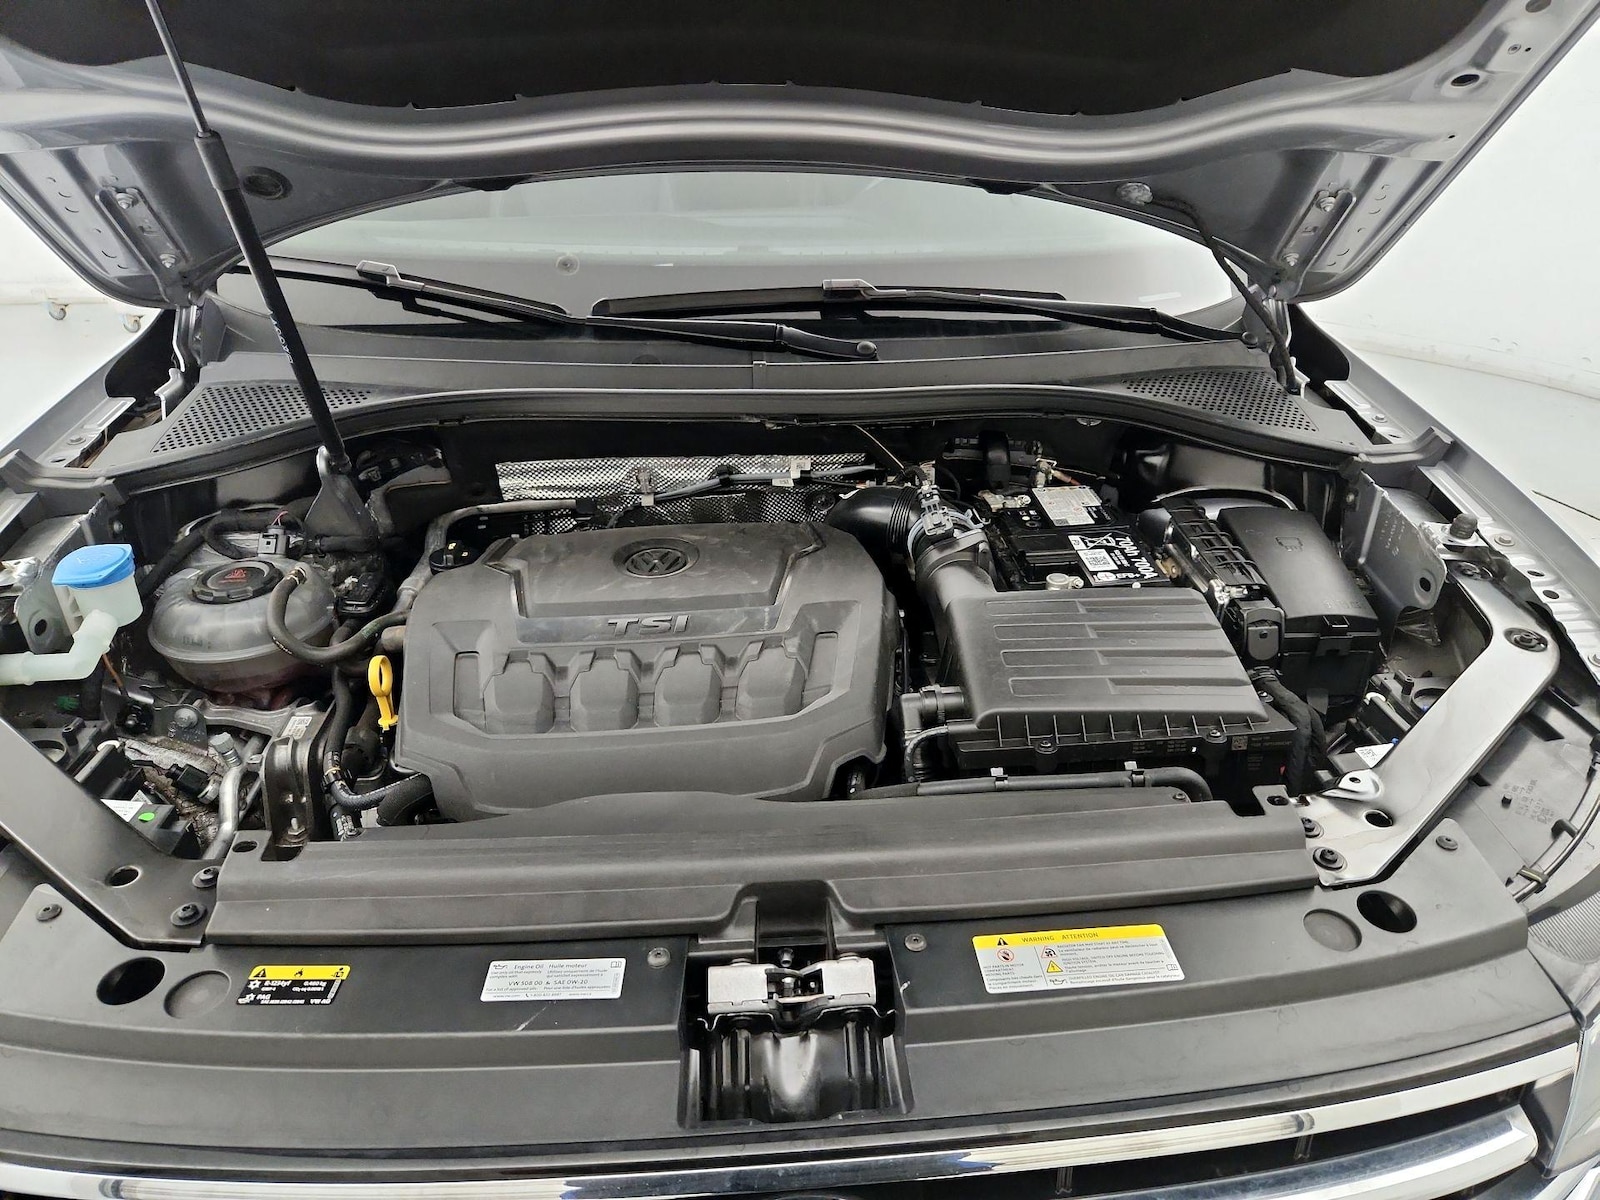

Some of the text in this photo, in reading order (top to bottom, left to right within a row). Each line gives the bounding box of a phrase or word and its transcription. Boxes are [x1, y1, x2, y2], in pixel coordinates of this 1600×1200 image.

[1116, 536, 1140, 556] 70Ah
[1130, 557, 1158, 579] 700A
[608, 615, 689, 636] TSI
